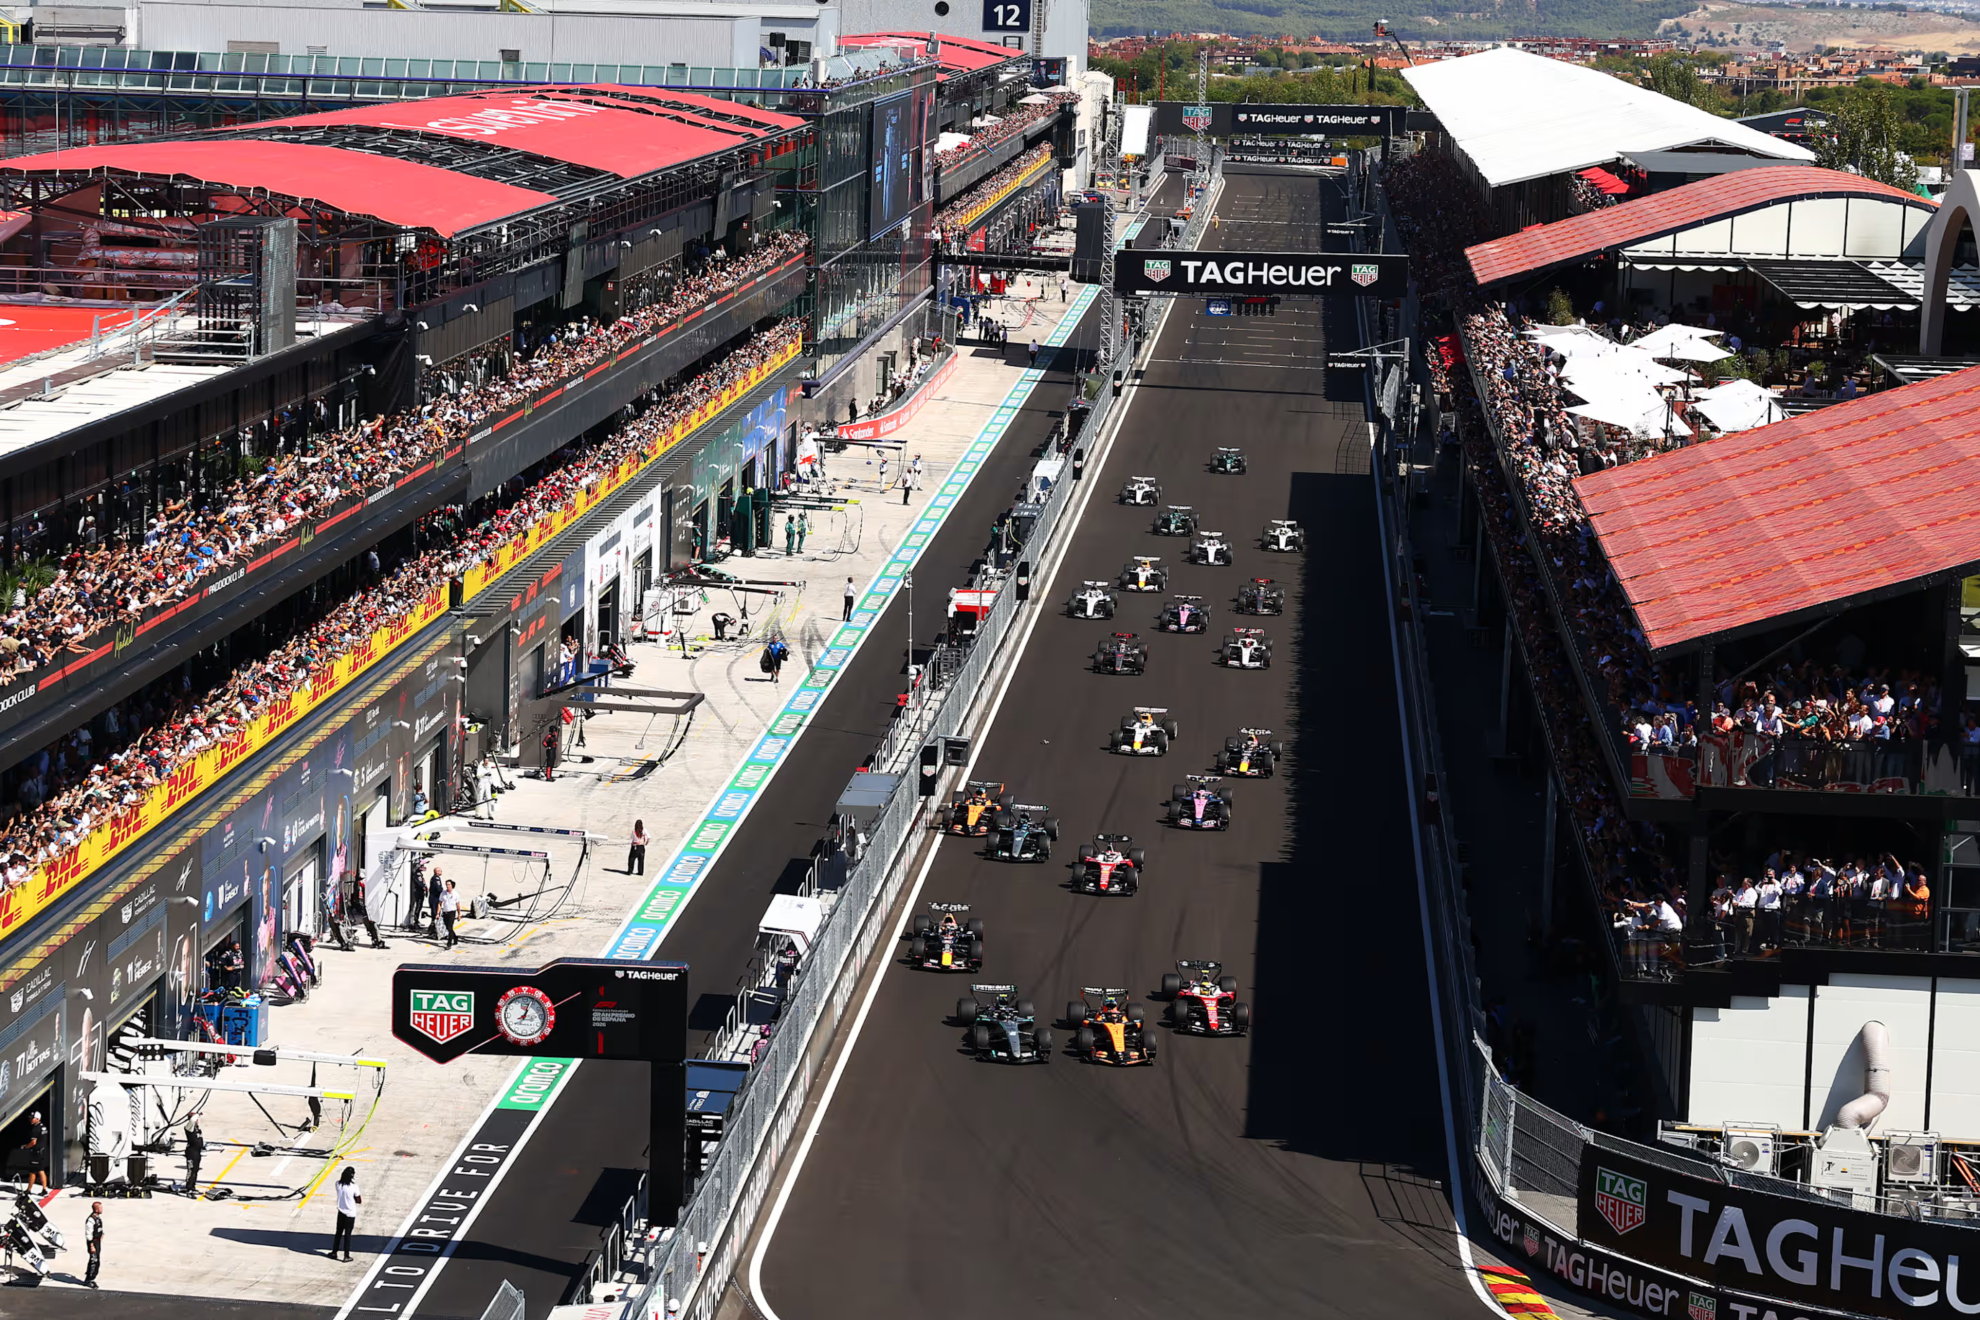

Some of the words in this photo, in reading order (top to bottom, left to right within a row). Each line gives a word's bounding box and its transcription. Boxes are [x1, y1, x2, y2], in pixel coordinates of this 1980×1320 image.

[993, 4, 1020, 26] 12
[1250, 114, 1301, 123] TAGHeuer
[1316, 115, 1368, 125] TAGHeuer
[1145, 269, 1170, 281] HEUER
[1148, 261, 1169, 269] TAG
[1181, 261, 1342, 287] TAGHeuer
[1355, 265, 1377, 274] TAG
[1352, 273, 1378, 286] HEUER
[849, 427, 875, 438] Santander
[208, 572, 232, 595] PADDOCK
[232, 567, 245, 583] CLUB
[115, 621, 135, 658] Madrid
[17, 684, 36, 702] CLUB
[312, 664, 335, 703] DHL
[789, 690, 820, 710] aramco
[267, 699, 294, 736] DHL
[771, 714, 804, 735] aramco
[754, 738, 788, 760] aramco
[167, 763, 197, 809] DHL
[734, 764, 770, 788] aramco
[713, 793, 750, 817] aramco
[1014, 803, 1044, 811] PETRONAS
[298, 813, 320, 838] COLAPINTO
[691, 823, 729, 849] aramco
[44, 847, 82, 899] DHL
[667, 855, 706, 883] aramco
[225, 884, 240, 903] GASLY
[640, 890, 682, 920] aramco
[611, 927, 657, 960] aramco
[26, 966, 52, 994] CADILLAC
[127, 961, 134, 984] 11
[626, 971, 679, 981] TAGHeuer
[415, 993, 469, 1012] TAG
[413, 1013, 471, 1043] HEUER
[16, 1052, 26, 1079] 77
[26, 1048, 51, 1075] BOTTAS
[509, 1062, 563, 1104] aramco
[777, 1070, 806, 1157] TAGHeuer
[740, 1146, 771, 1244] TAGHeuer
[1602, 1172, 1642, 1203] TAG
[374, 1265, 425, 1289] TO
[401, 1189, 478, 1252] DRIVE
[454, 1143, 509, 1176] FOR
[1475, 1168, 1520, 1245] TAGHeuer
[1598, 1195, 1643, 1232] HEUER
[1525, 1225, 1538, 1242] TAG
[1524, 1239, 1539, 1257] HEUER
[696, 1233, 732, 1320] TAGHeuer
[1545, 1236, 1680, 1315] TAGHeuer
[1691, 1294, 1713, 1309] TAG
